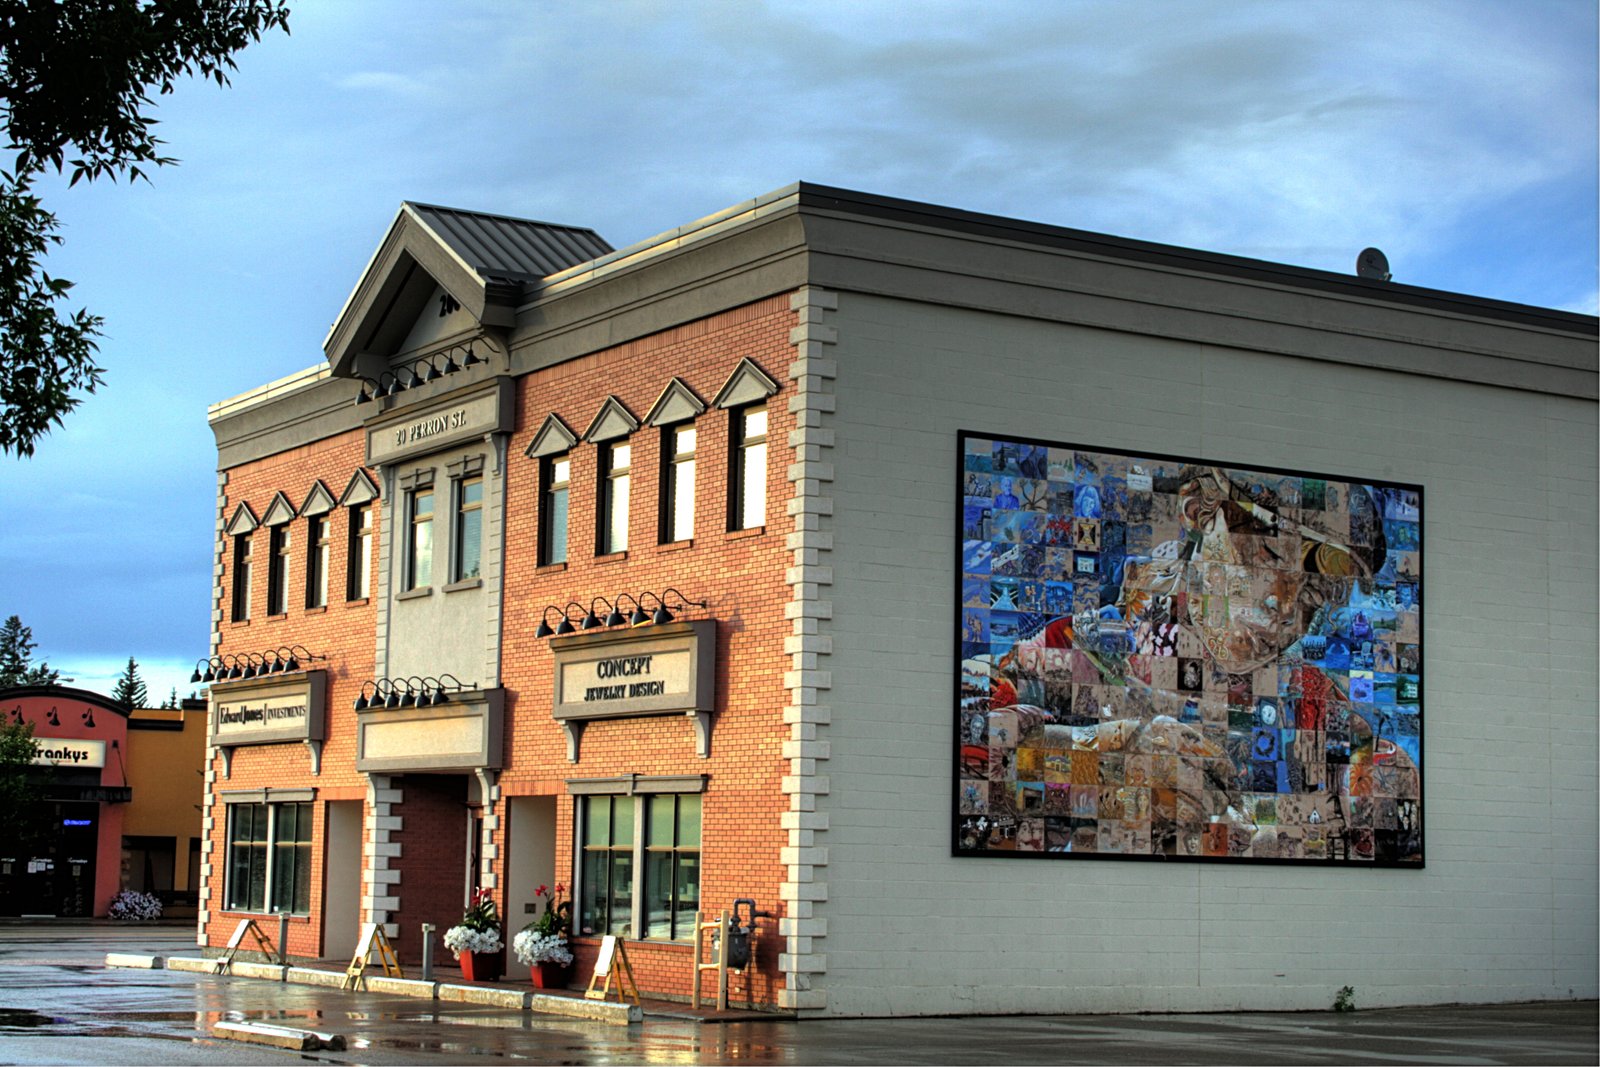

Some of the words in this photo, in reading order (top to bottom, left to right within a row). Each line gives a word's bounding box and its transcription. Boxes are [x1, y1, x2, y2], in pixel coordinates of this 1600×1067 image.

[409, 415, 449, 442] PERRON
[450, 409, 467, 429] ST.
[597, 655, 653, 679] CONCEPT
[584, 684, 627, 701] JEWELRY
[629, 680, 665, 698] DESIGN
